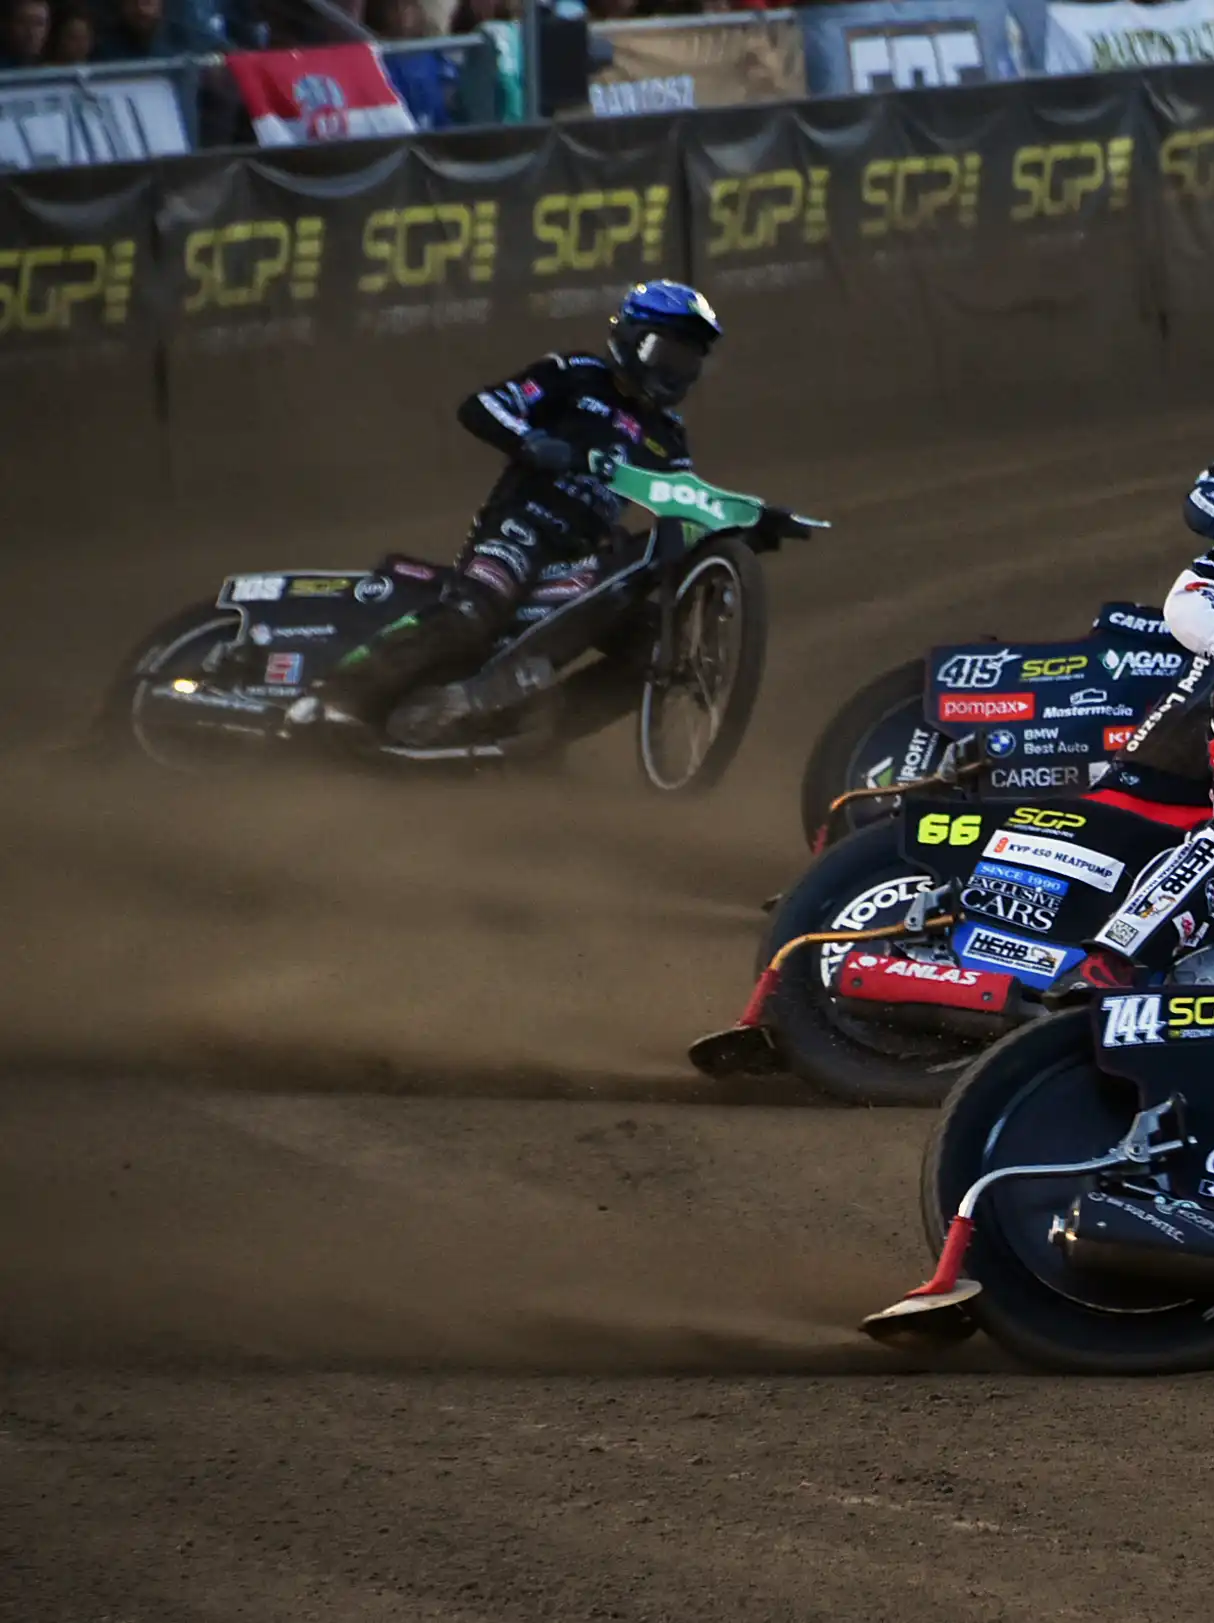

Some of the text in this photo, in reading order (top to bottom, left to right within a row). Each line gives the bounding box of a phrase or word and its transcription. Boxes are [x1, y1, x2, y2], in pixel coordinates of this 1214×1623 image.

[937, 649, 1015, 688] 415
[1020, 655, 1089, 678] SGP
[943, 700, 1018, 717] pompax
[1043, 704, 1134, 719] Mastermedia
[1024, 727, 1060, 741] BMW
[1024, 741, 1090, 755] Best Auto
[990, 766, 1080, 788] CARGER
[917, 813, 983, 846] 66
[1008, 806, 1087, 830] SGP
[980, 864, 1024, 881] SINCE
[1054, 851, 1114, 879] HEATPUMP
[831, 879, 935, 931] TOOLS
[968, 876, 1060, 911] EXCLUSIVE
[960, 888, 1056, 931] CARS
[884, 960, 983, 986] ANLAS
